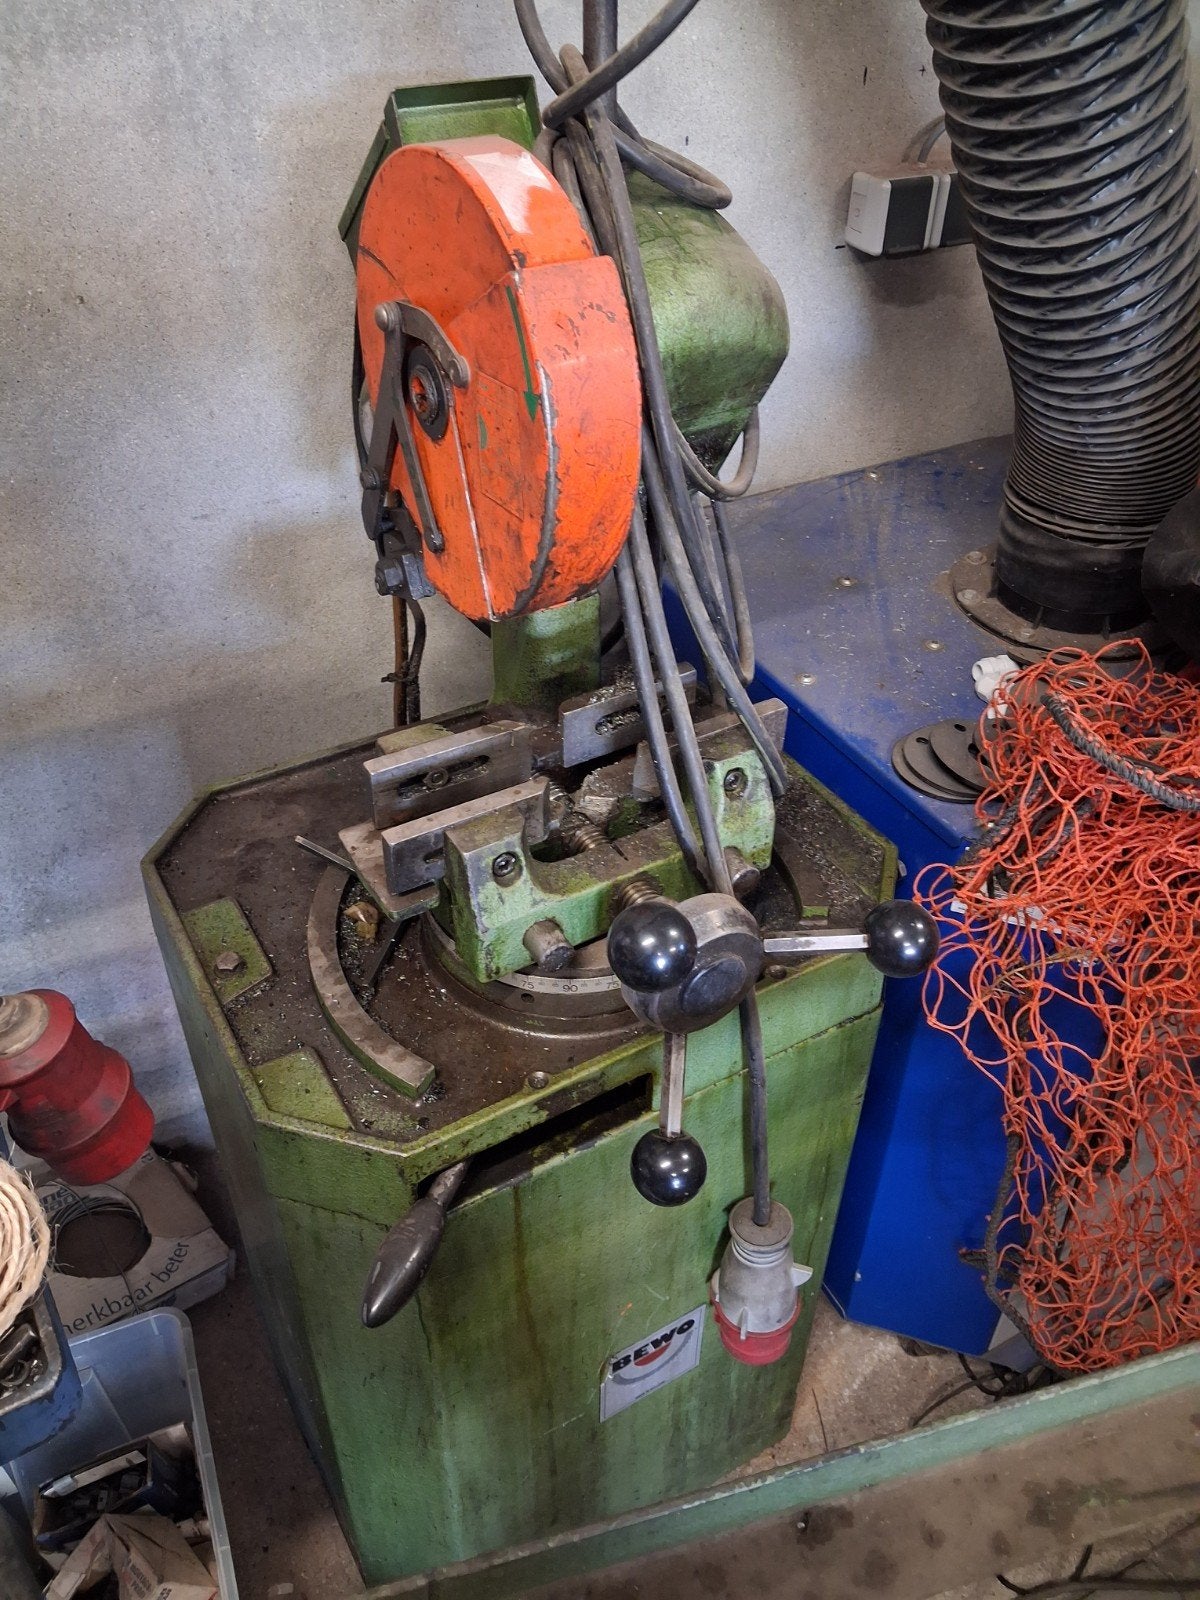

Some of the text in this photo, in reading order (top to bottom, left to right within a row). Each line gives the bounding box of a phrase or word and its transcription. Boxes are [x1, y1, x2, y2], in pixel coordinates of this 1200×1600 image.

[521, 980, 535, 990] 75
[562, 984, 579, 993] 90
[606, 980, 620, 989] 75
[150, 1242, 190, 1284] beter
[612, 1319, 695, 1374] BEWO
